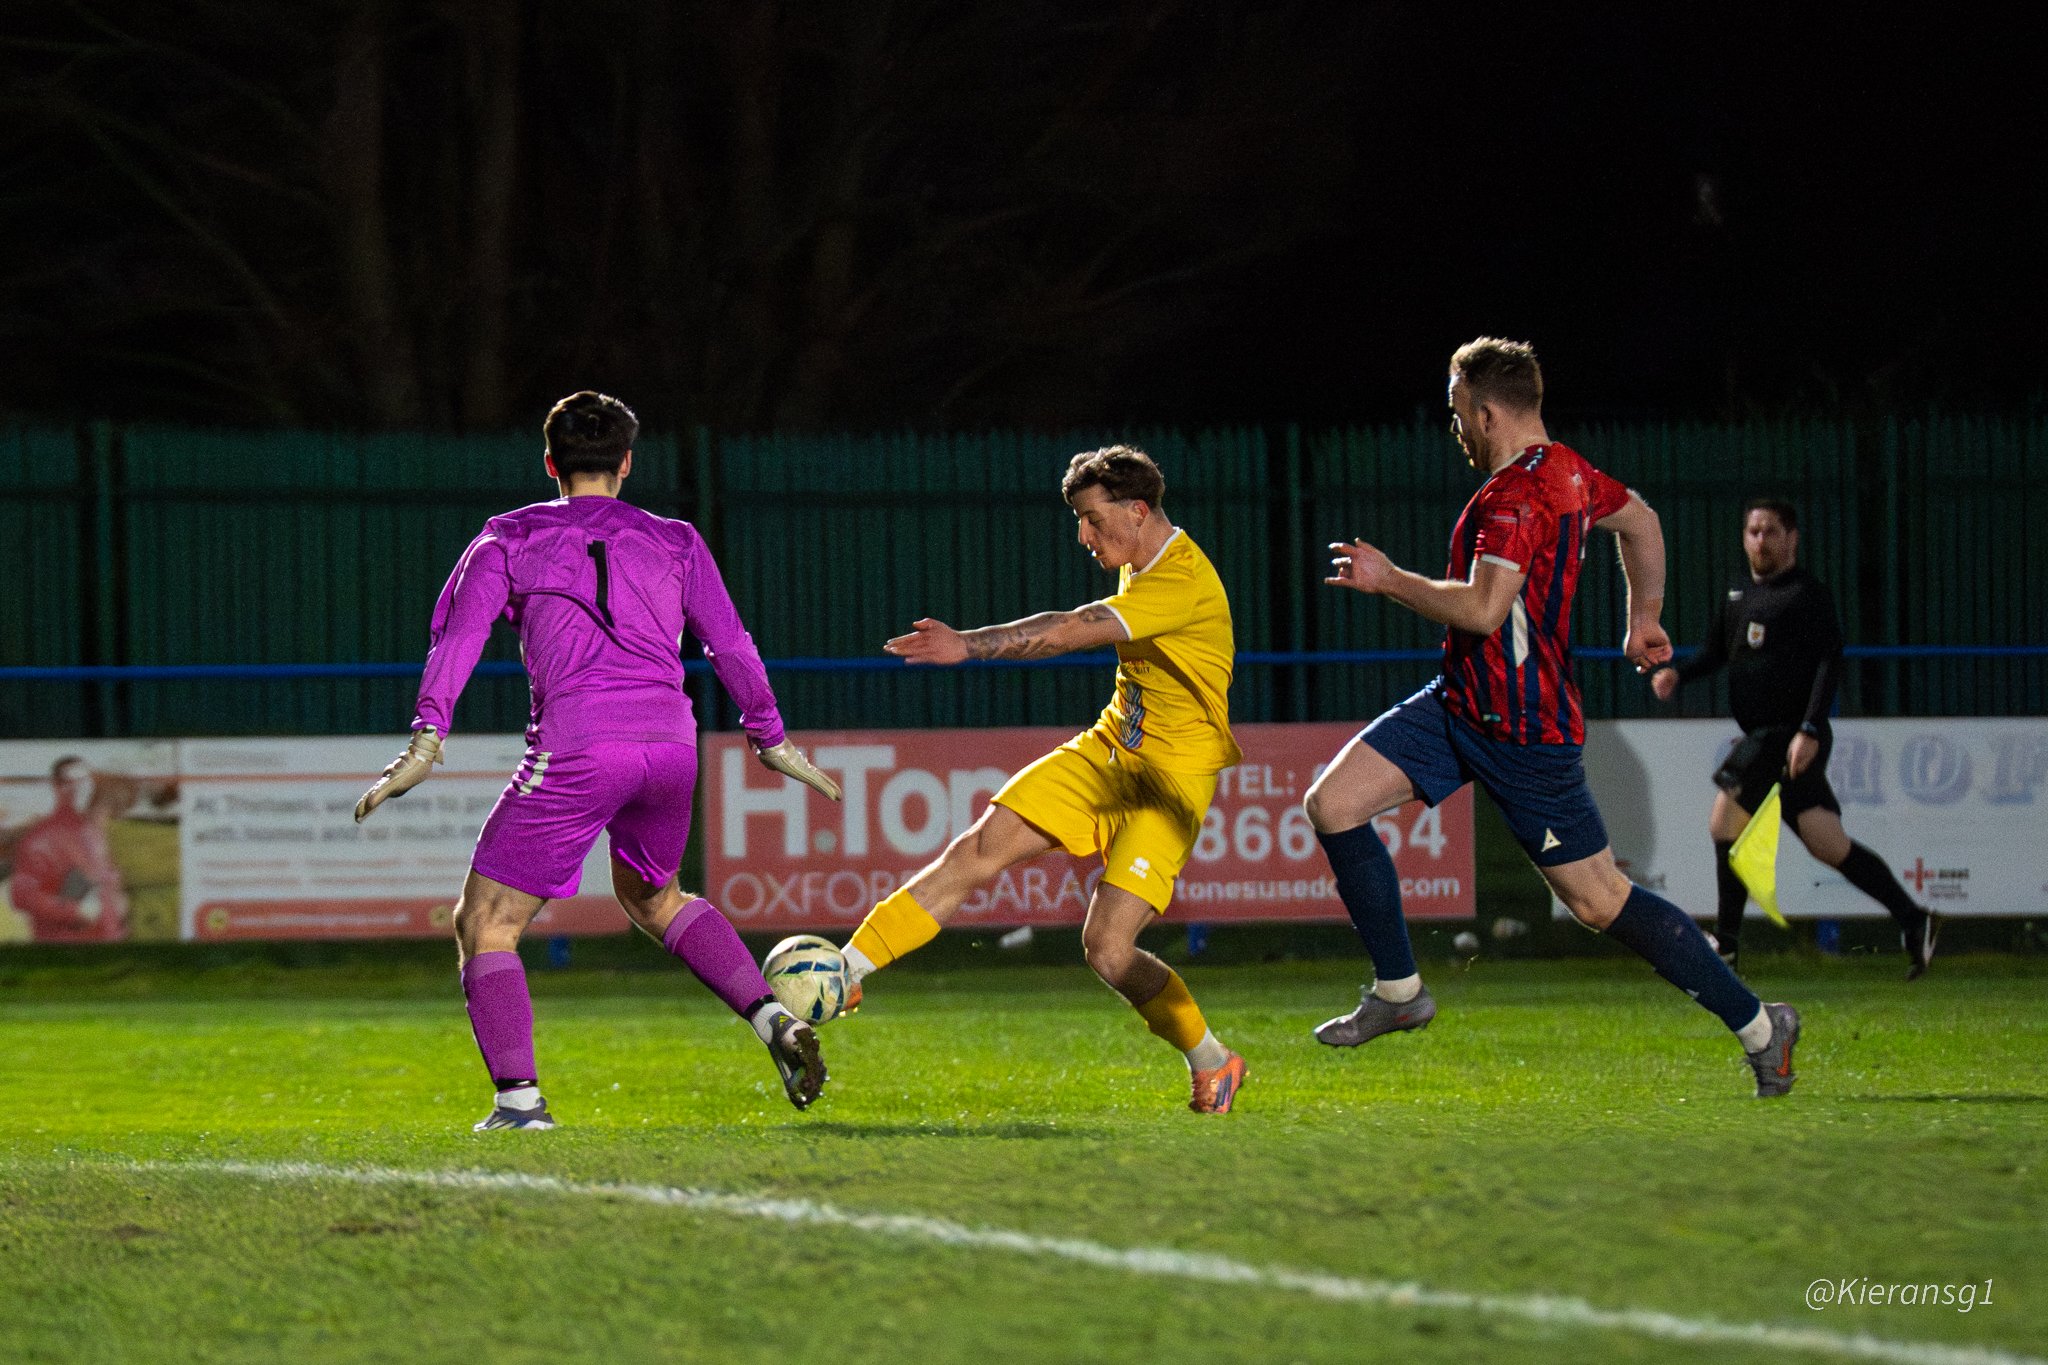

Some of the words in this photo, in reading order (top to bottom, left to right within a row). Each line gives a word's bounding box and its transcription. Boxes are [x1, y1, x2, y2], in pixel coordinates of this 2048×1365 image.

[587, 539, 616, 629] 1
[1219, 763, 1297, 798] TEL:
[1192, 804, 1447, 862] 86654
[721, 871, 916, 919] OXFOR
